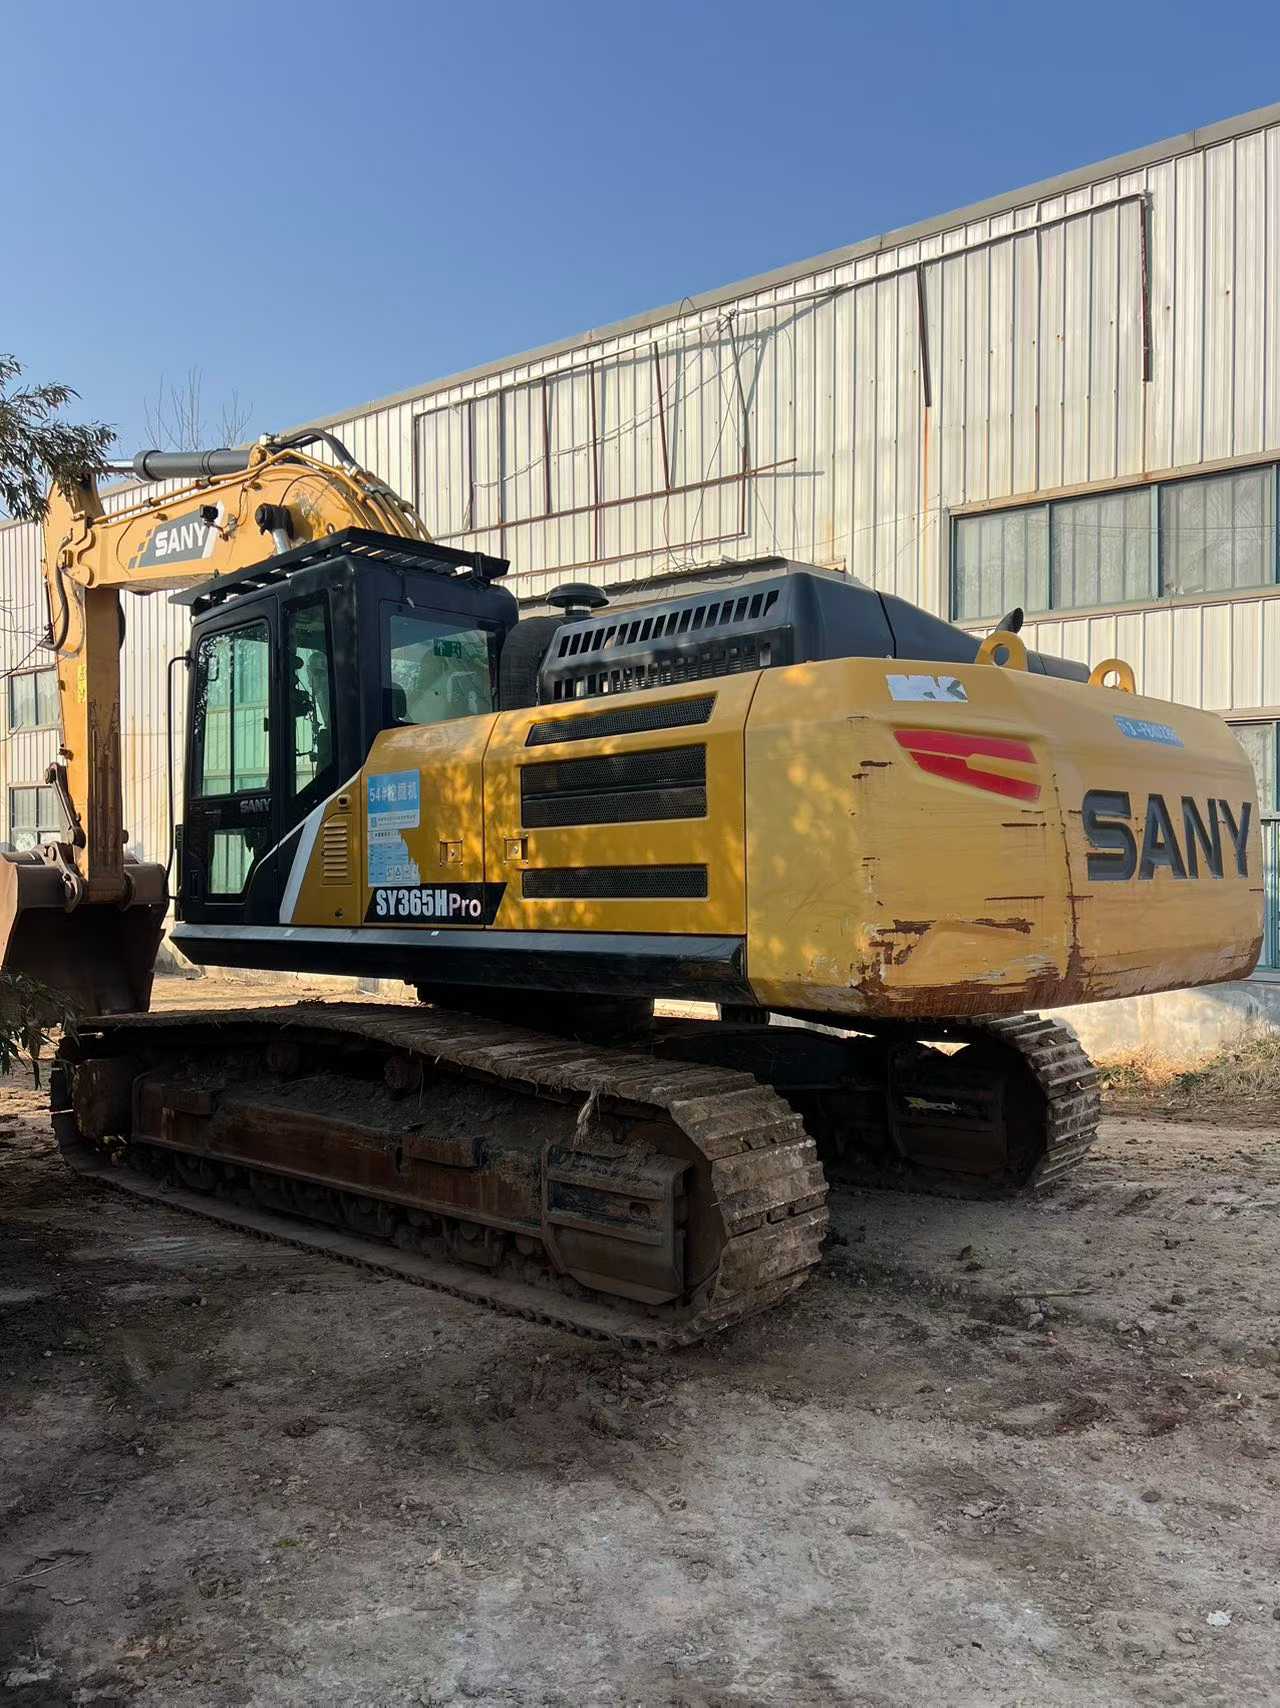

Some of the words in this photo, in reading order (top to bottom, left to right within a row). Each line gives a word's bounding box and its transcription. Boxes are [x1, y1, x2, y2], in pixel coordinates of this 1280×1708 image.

[155, 521, 207, 557] SANY
[240, 798, 272, 814] SANY
[1082, 789, 1252, 881] SANY
